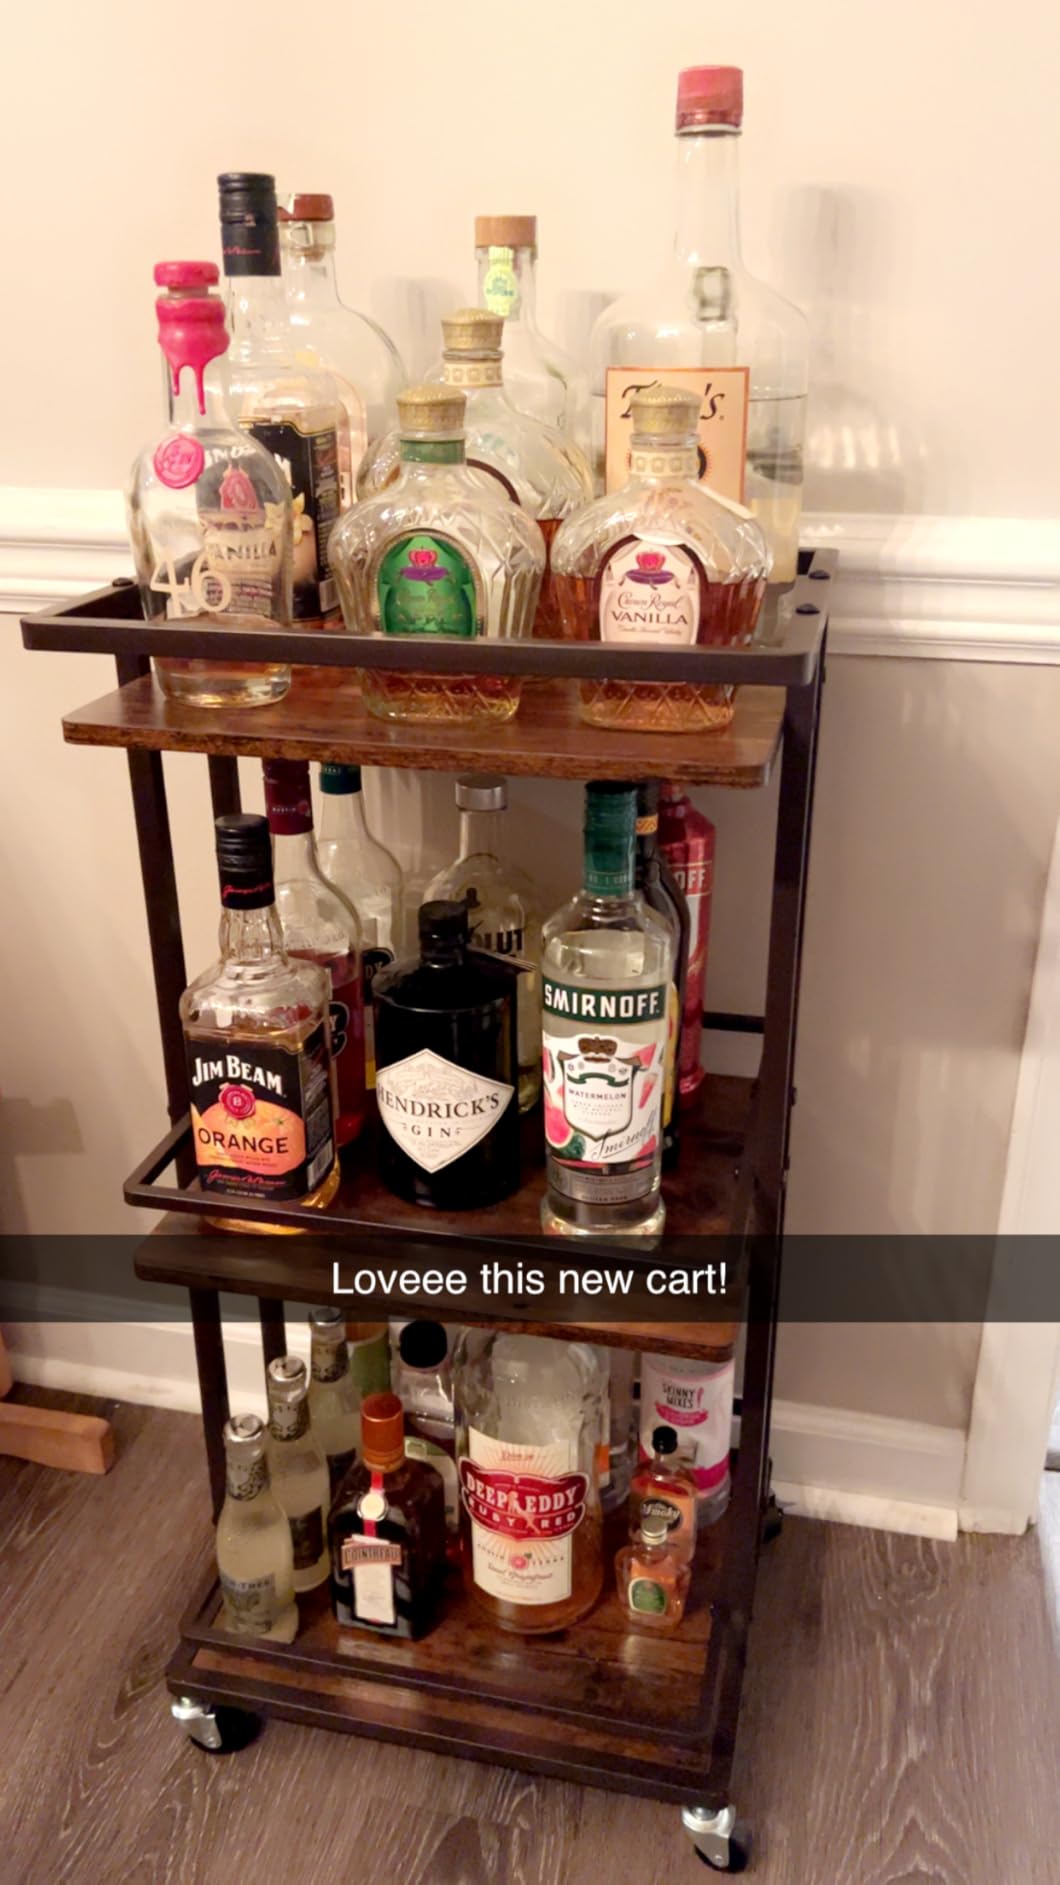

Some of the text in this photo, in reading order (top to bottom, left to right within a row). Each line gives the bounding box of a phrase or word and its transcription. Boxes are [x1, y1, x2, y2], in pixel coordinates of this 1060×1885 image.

[620, 380, 725, 421] T's
[611, 610, 688, 625] VANILLA
[544, 983, 659, 1018] SMIRNOFF
[192, 1054, 284, 1096] JIM BEAM
[568, 1088, 627, 1100] WATERMELON
[411, 1124, 451, 1138] GIN
[197, 1127, 289, 1154] ORANGE
[662, 1383, 695, 1397] SKINNY
[666, 1396, 694, 1409] MIXES
[466, 1471, 577, 1513] DEEP EDDY
[540, 1511, 576, 1529] RED
